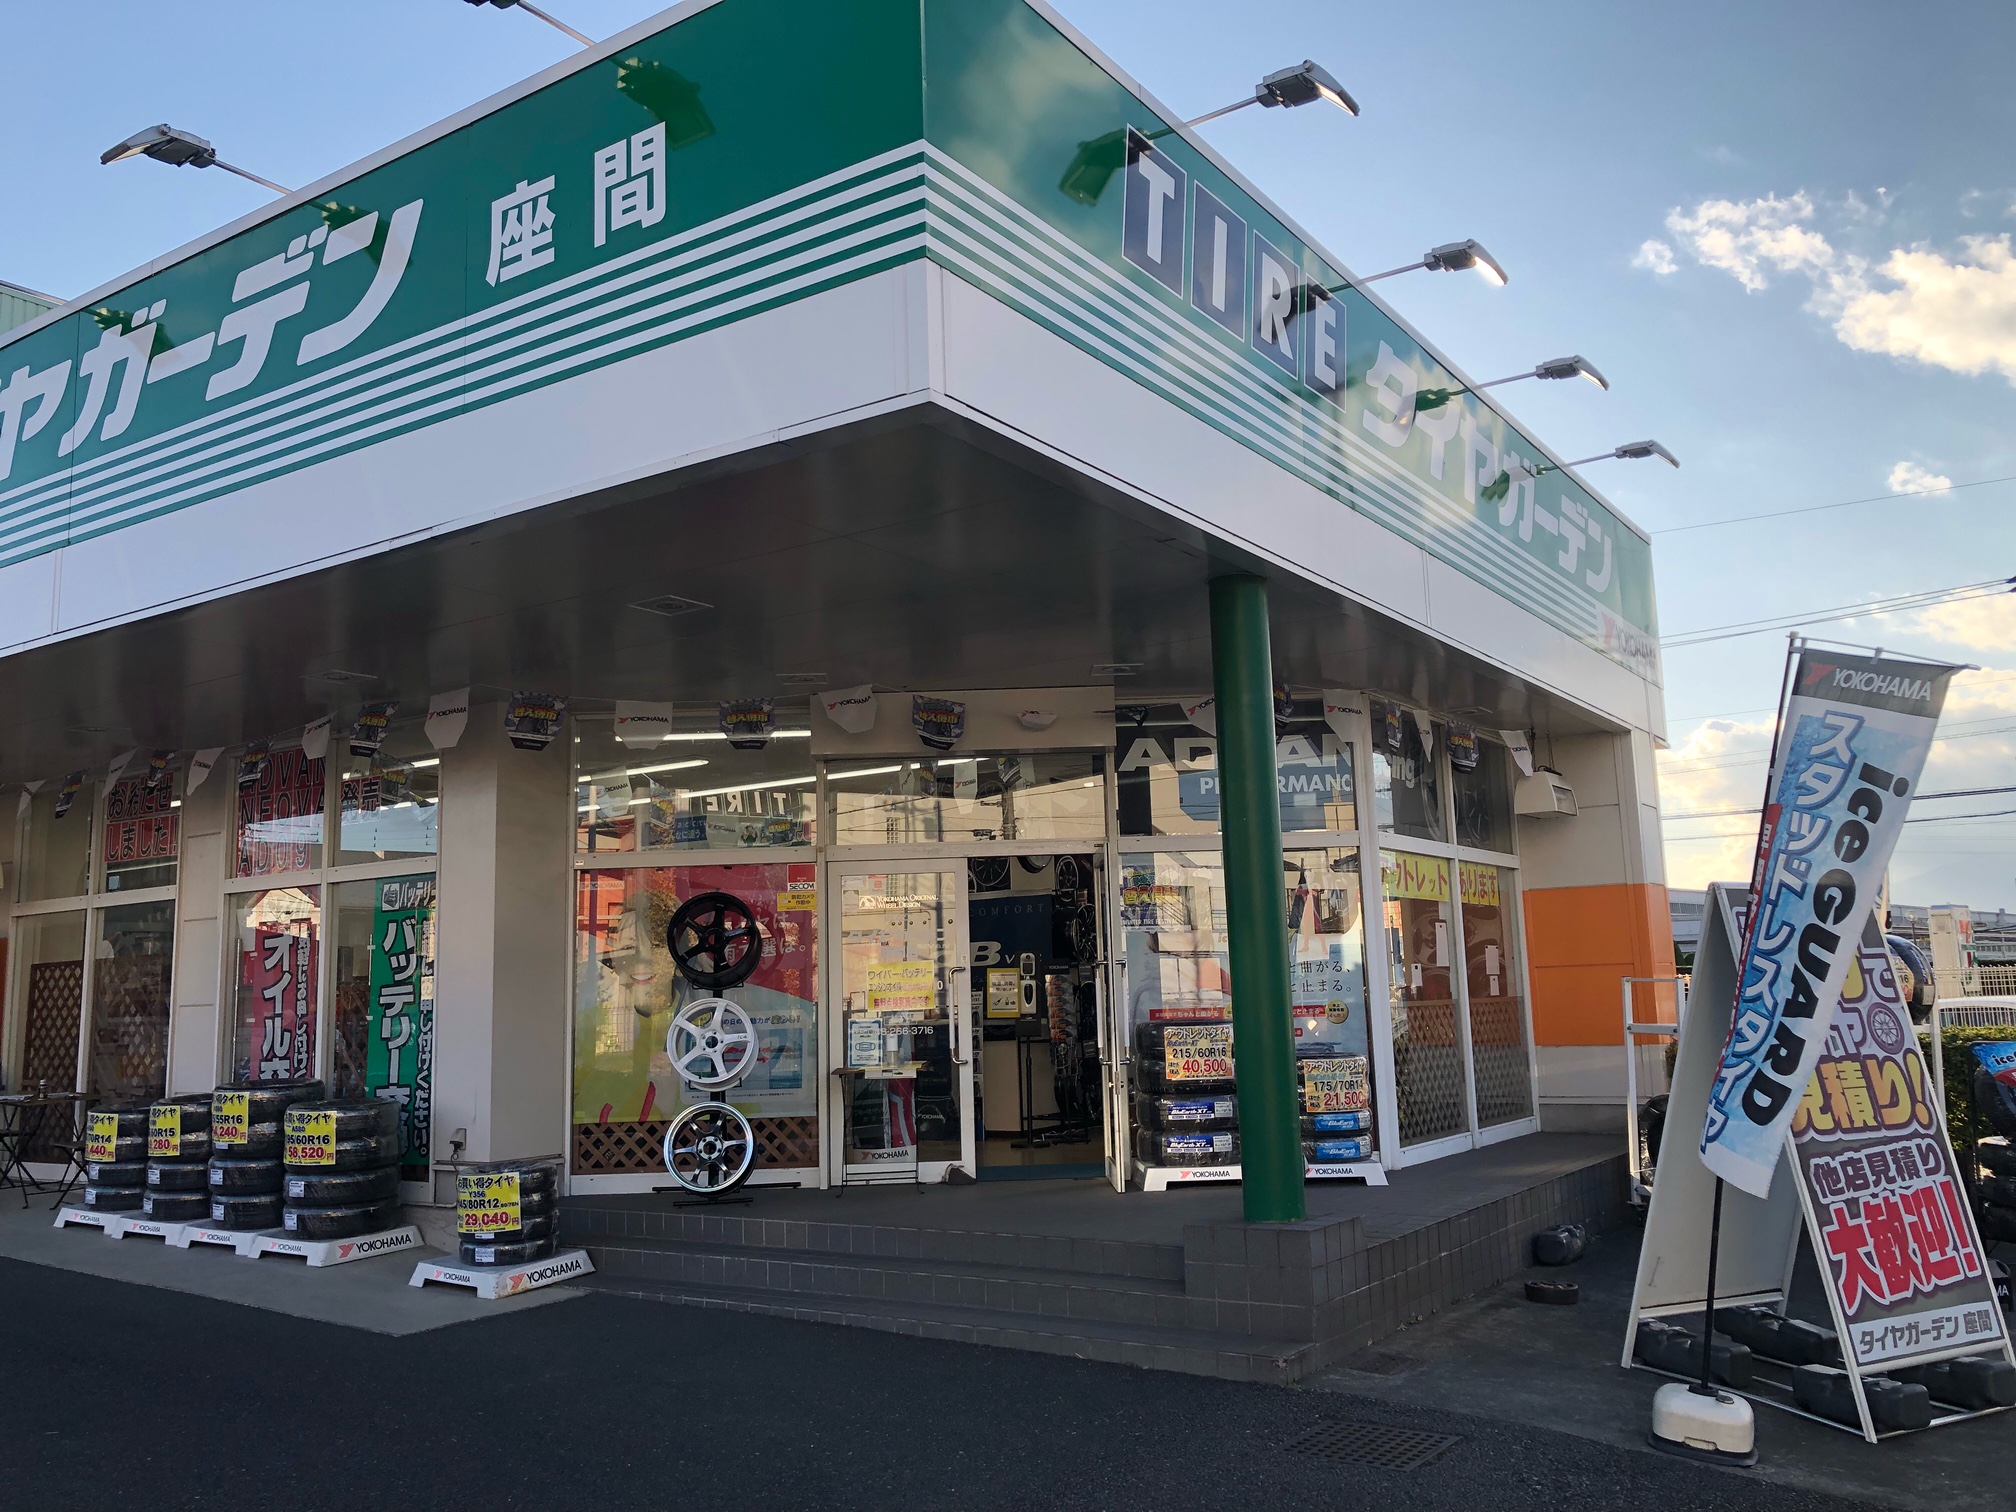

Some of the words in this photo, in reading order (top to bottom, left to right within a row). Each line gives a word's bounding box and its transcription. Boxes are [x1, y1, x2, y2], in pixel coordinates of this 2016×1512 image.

[485, 121, 666, 287] 座間
[1139, 152, 1337, 391] TIRE
[1362, 340, 1613, 593] タイヤガーデン
[1833, 668, 1931, 701] YOKOHAMA
[436, 707, 467, 717] YOKOHAMA
[1118, 734, 1353, 771] ADAN
[1741, 762, 1909, 1127] iceGUARD
[1165, 1027, 1230, 1039] アウトレットタイヤ
[1172, 1047, 1227, 1058] 215/60R16
[1183, 1059, 1227, 1074] 40,500
[1324, 1091, 1363, 1106] 21,500
[870, 1149, 909, 1160] YOKOHAMA
[1813, 1143, 1941, 1199] 他店見積り
[468, 1190, 486, 1198] Y356
[206, 1233, 232, 1242] YOKOHAMA
[277, 1242, 302, 1252] YOKOHAMA
[356, 1234, 412, 1254] YOKOHAMA
[1826, 1180, 1979, 1311] 大歓迎!
[443, 1272, 471, 1283] YOKOHAMA
[526, 1260, 582, 1283] YOKOHAMA
[1860, 1315, 1959, 1354] タイヤガーデン
[1963, 1309, 1993, 1336] 座間
